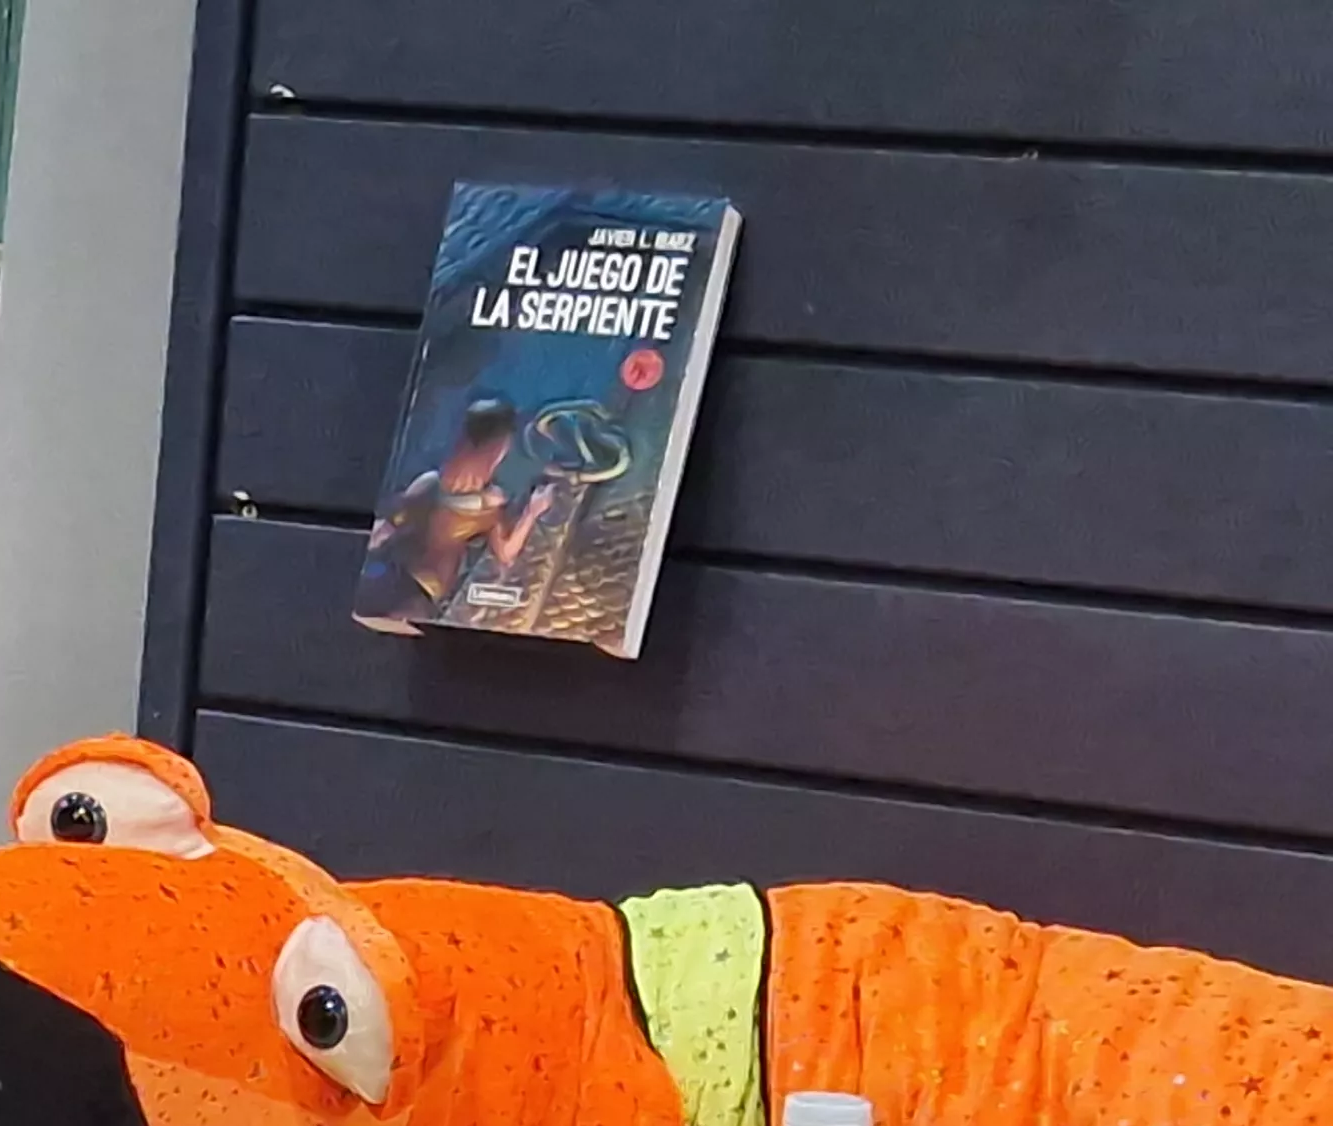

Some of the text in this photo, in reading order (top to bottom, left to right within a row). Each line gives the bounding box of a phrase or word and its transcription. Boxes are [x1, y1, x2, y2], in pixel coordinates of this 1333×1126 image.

[507, 245, 690, 297] EL JUEGO DE
[470, 286, 679, 340] LA SERPIENTE
